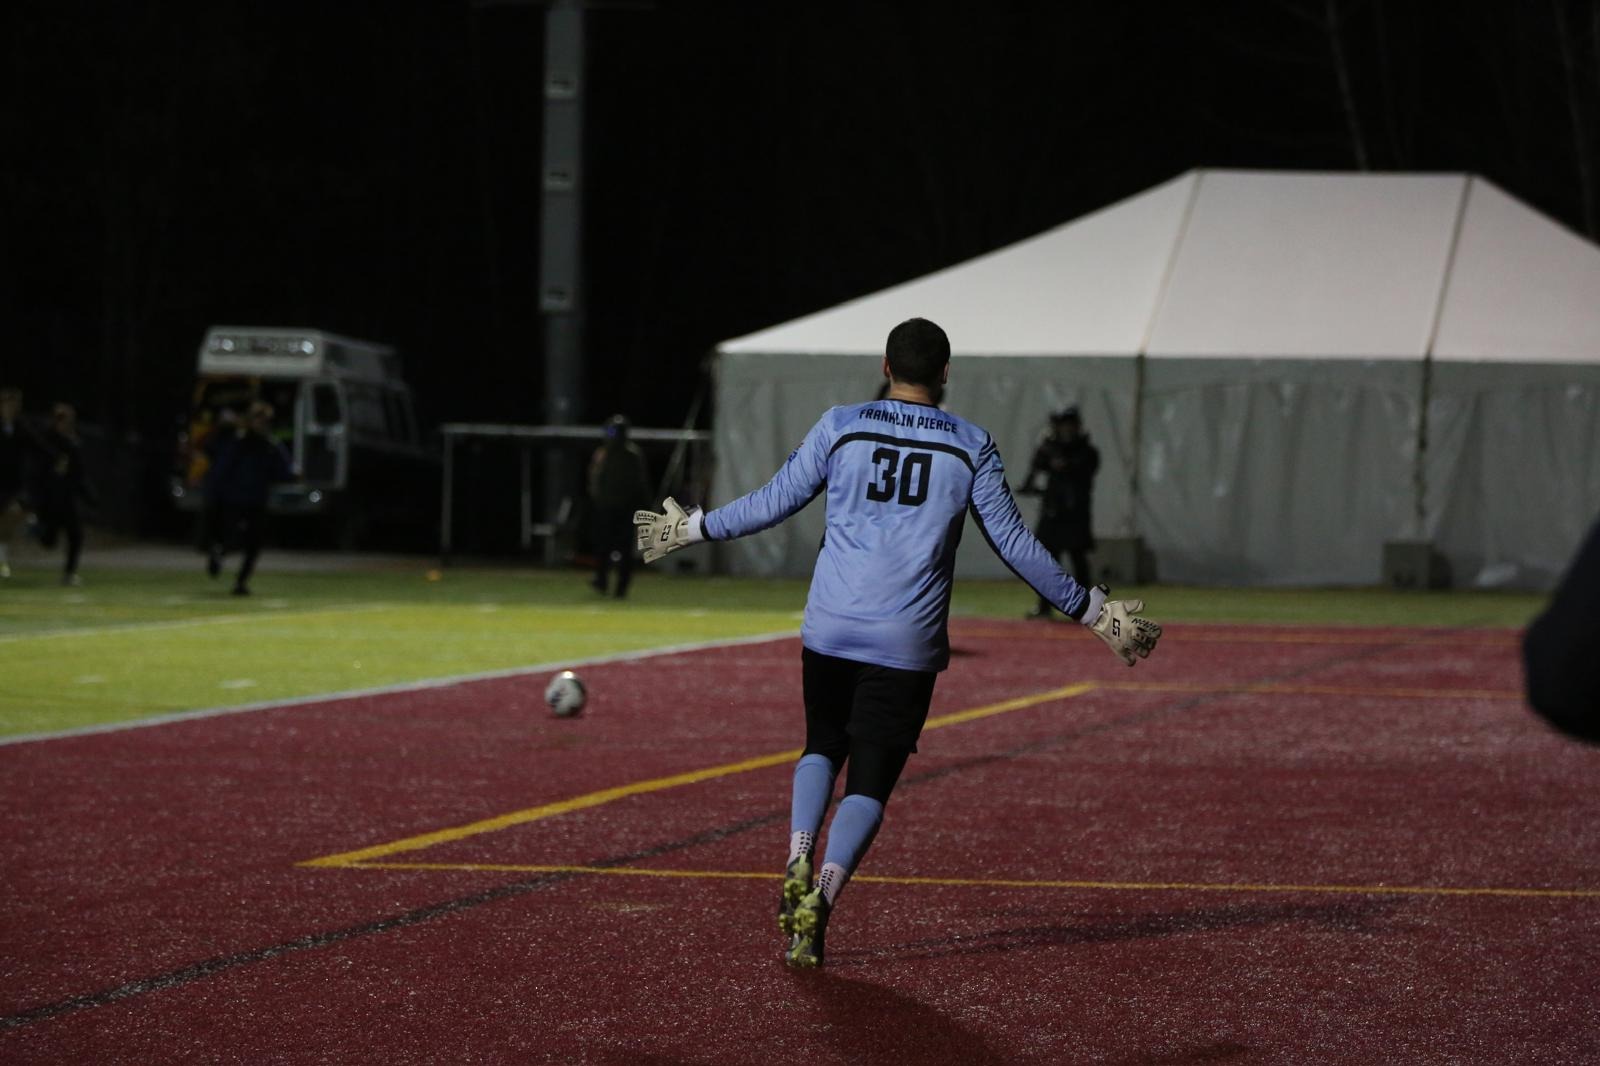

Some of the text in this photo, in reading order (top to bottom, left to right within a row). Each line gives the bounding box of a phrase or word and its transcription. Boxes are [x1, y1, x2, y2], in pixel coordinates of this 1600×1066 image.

[859, 408, 957, 434] FRANKLIN PIERCE
[866, 447, 933, 506] 30
